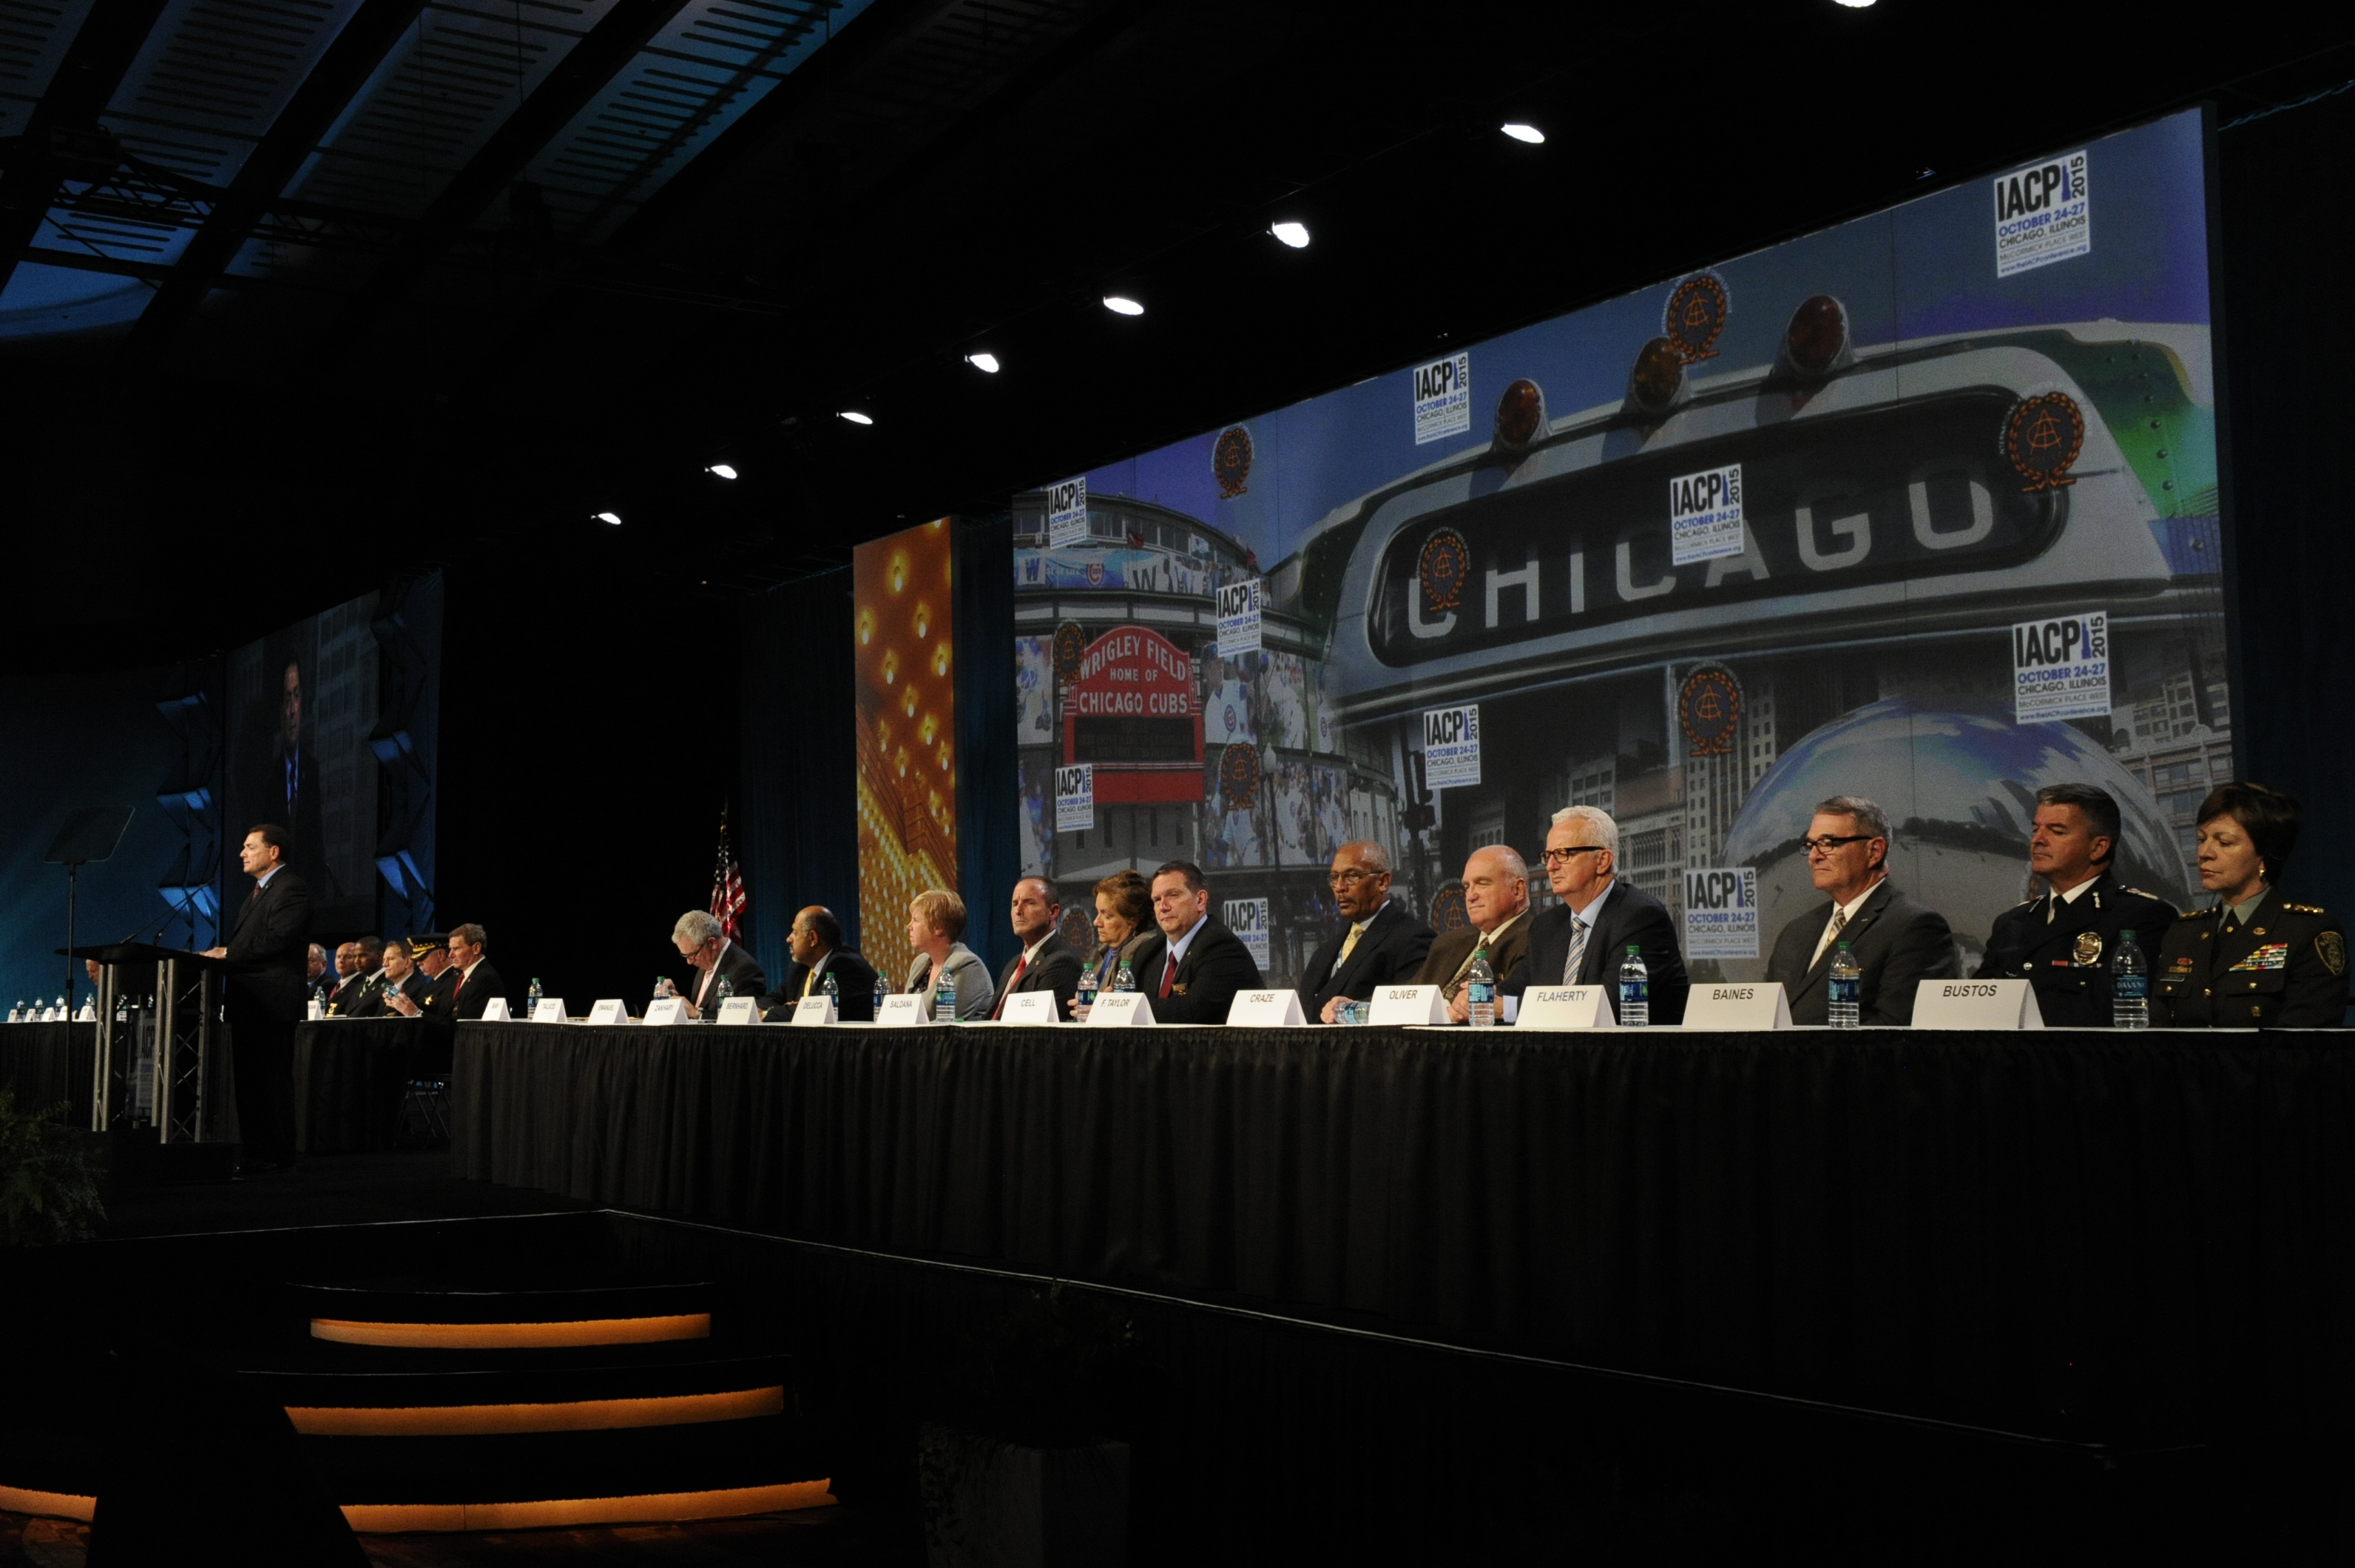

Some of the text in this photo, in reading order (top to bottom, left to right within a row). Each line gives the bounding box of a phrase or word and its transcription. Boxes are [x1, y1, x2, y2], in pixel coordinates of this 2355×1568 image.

[2071, 156, 2085, 198] 2015
[1997, 165, 2061, 222] IACP
[1998, 203, 2084, 237] OCTOBER 24-27
[2050, 215, 2086, 234] ILLINOIS
[1415, 362, 1453, 402] IACP
[1459, 356, 1467, 388] 2015
[1417, 391, 1467, 413] OCTOBER 24-27
[1446, 401, 1467, 413] ILLINOIS
[1673, 473, 1721, 517] IACP
[1729, 469, 1740, 504] 2015
[1050, 483, 1075, 514] IACP
[1051, 513, 1071, 524] OCTOBER
[1675, 508, 1740, 530] OCTOBER 24-27
[1712, 520, 1740, 532] ILLINOIS
[1218, 585, 1248, 619] IACP
[1218, 617, 1243, 629] OCTOBER
[2016, 620, 2081, 668] IACP
[2090, 616, 2105, 658] 2015
[1080, 635, 1141, 680] WRIGLEY
[1146, 638, 1186, 681] FIELD
[1109, 668, 1158, 681] HOME OF
[2018, 663, 2106, 683] OCTOBER 24-27
[2070, 676, 2106, 689] ILLINOIS
[1079, 692, 1187, 714] CHICAGO CUBS
[1426, 710, 1463, 746] IACP
[1469, 709, 1477, 740] 2015
[1427, 744, 1478, 759] OCTOBER 24-27
[1457, 754, 1478, 763] ILLINOIS
[1057, 768, 1081, 797] IACP
[1058, 799, 1078, 807] OCTOBER
[1686, 871, 1736, 909] IACP
[1743, 871, 1754, 908] 2015
[1226, 902, 1255, 932] IACP
[1688, 912, 1755, 924] OCTOBER 24-27
[1253, 933, 1267, 942] 24-27
[1728, 923, 1755, 932] ILLINOIS
[1250, 994, 1275, 1003] CRAZE
[1389, 990, 1418, 1000] OLIVER
[1536, 990, 1588, 1001] FLAHERTY
[1712, 988, 1754, 1000] BAINES
[1942, 985, 1997, 997] BUSTOS
[803, 1001, 822, 1010] DELUCCA
[1021, 999, 1035, 1007] CELL
[1101, 999, 1130, 1007] F. TAYLOR
